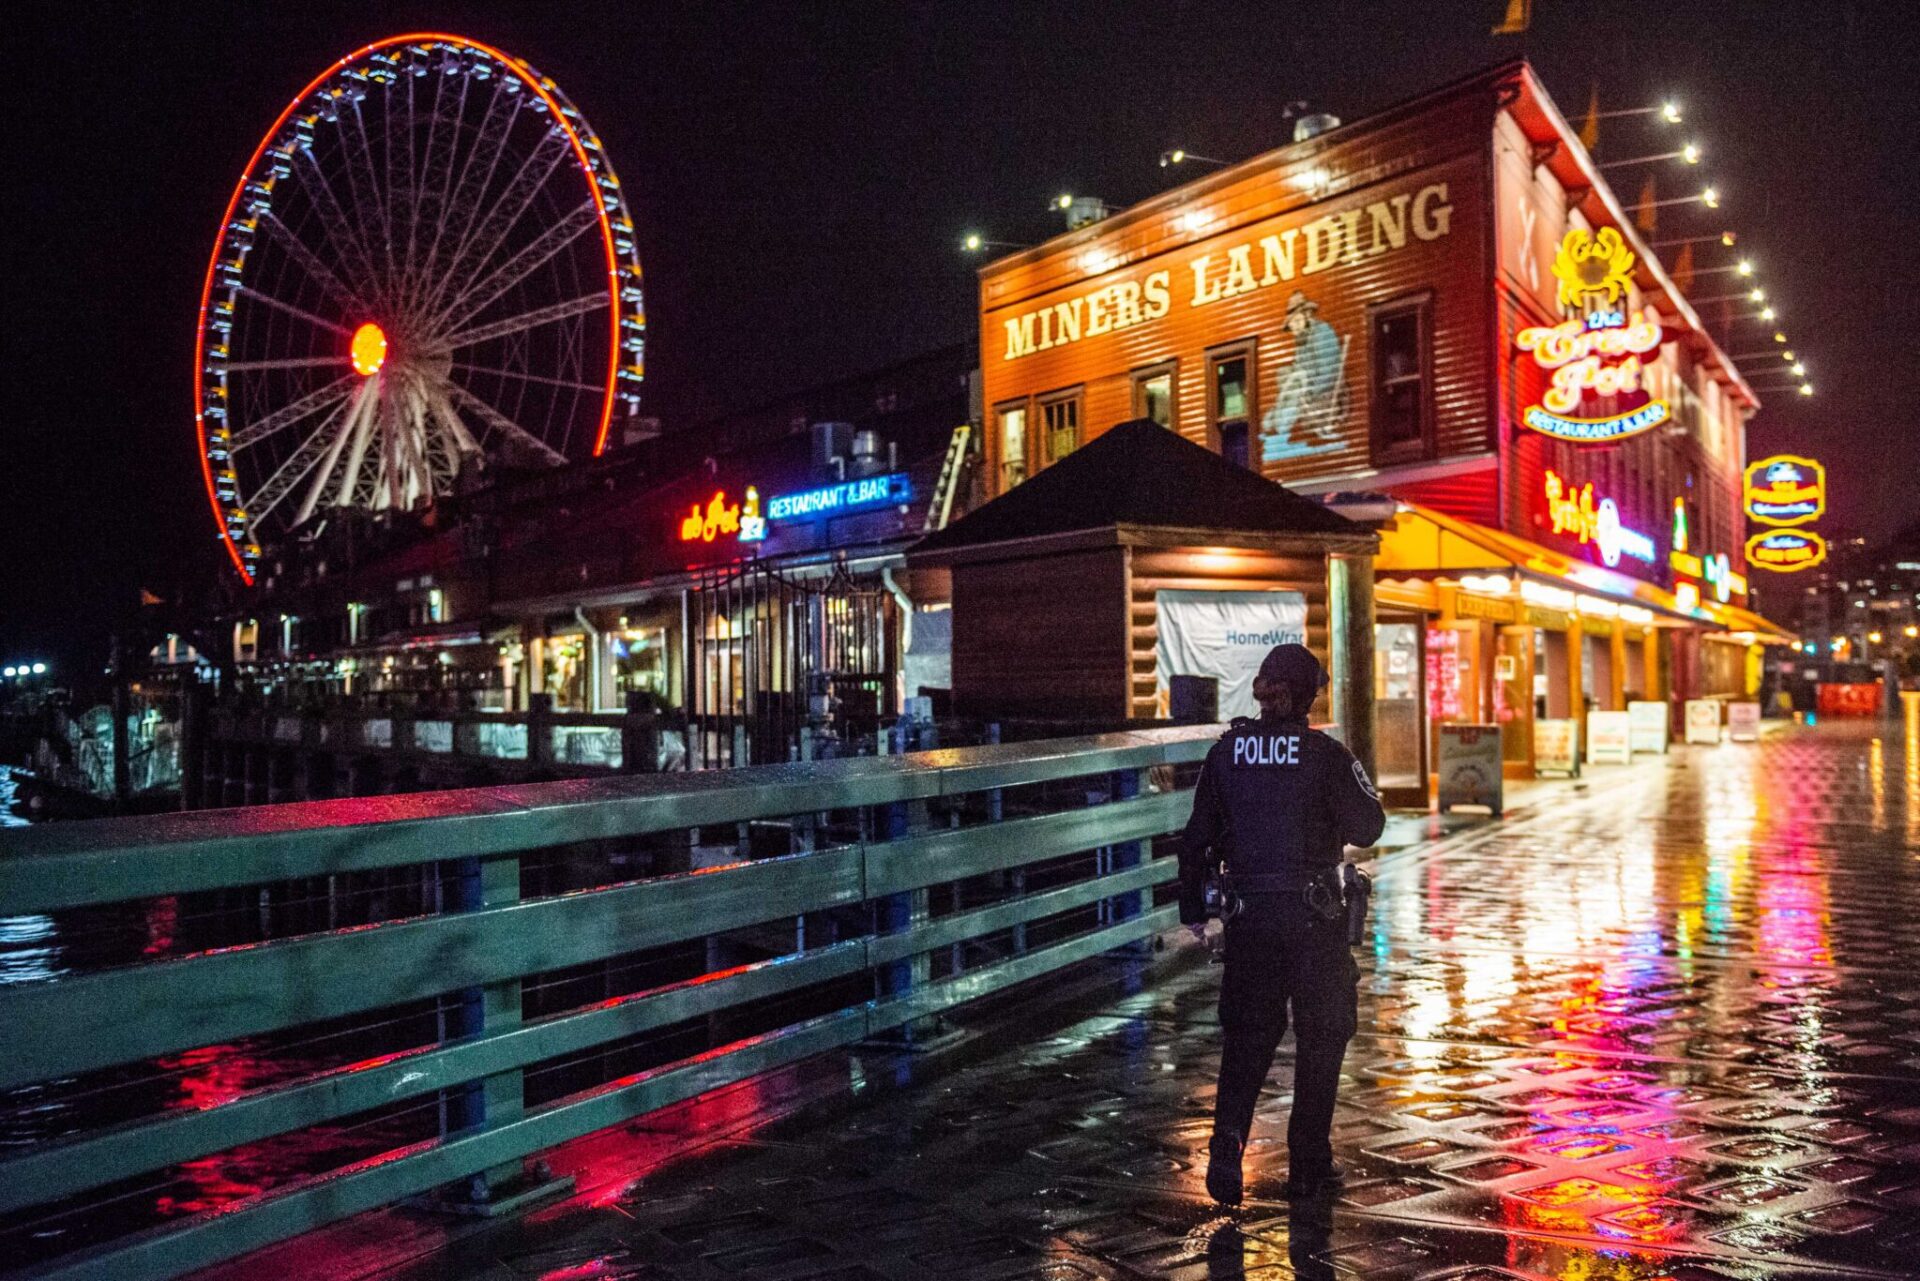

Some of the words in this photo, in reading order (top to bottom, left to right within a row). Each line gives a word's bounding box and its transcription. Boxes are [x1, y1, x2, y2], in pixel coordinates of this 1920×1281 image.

[1003, 269, 1171, 361] MINERS
[1190, 182, 1455, 308] LANDING
[1527, 408, 1620, 438] RESTAURANT
[1632, 404, 1666, 431] BAR
[767, 486, 846, 519] RESTAURANT
[859, 476, 889, 501] BAR
[1233, 735, 1301, 766] POLICE
